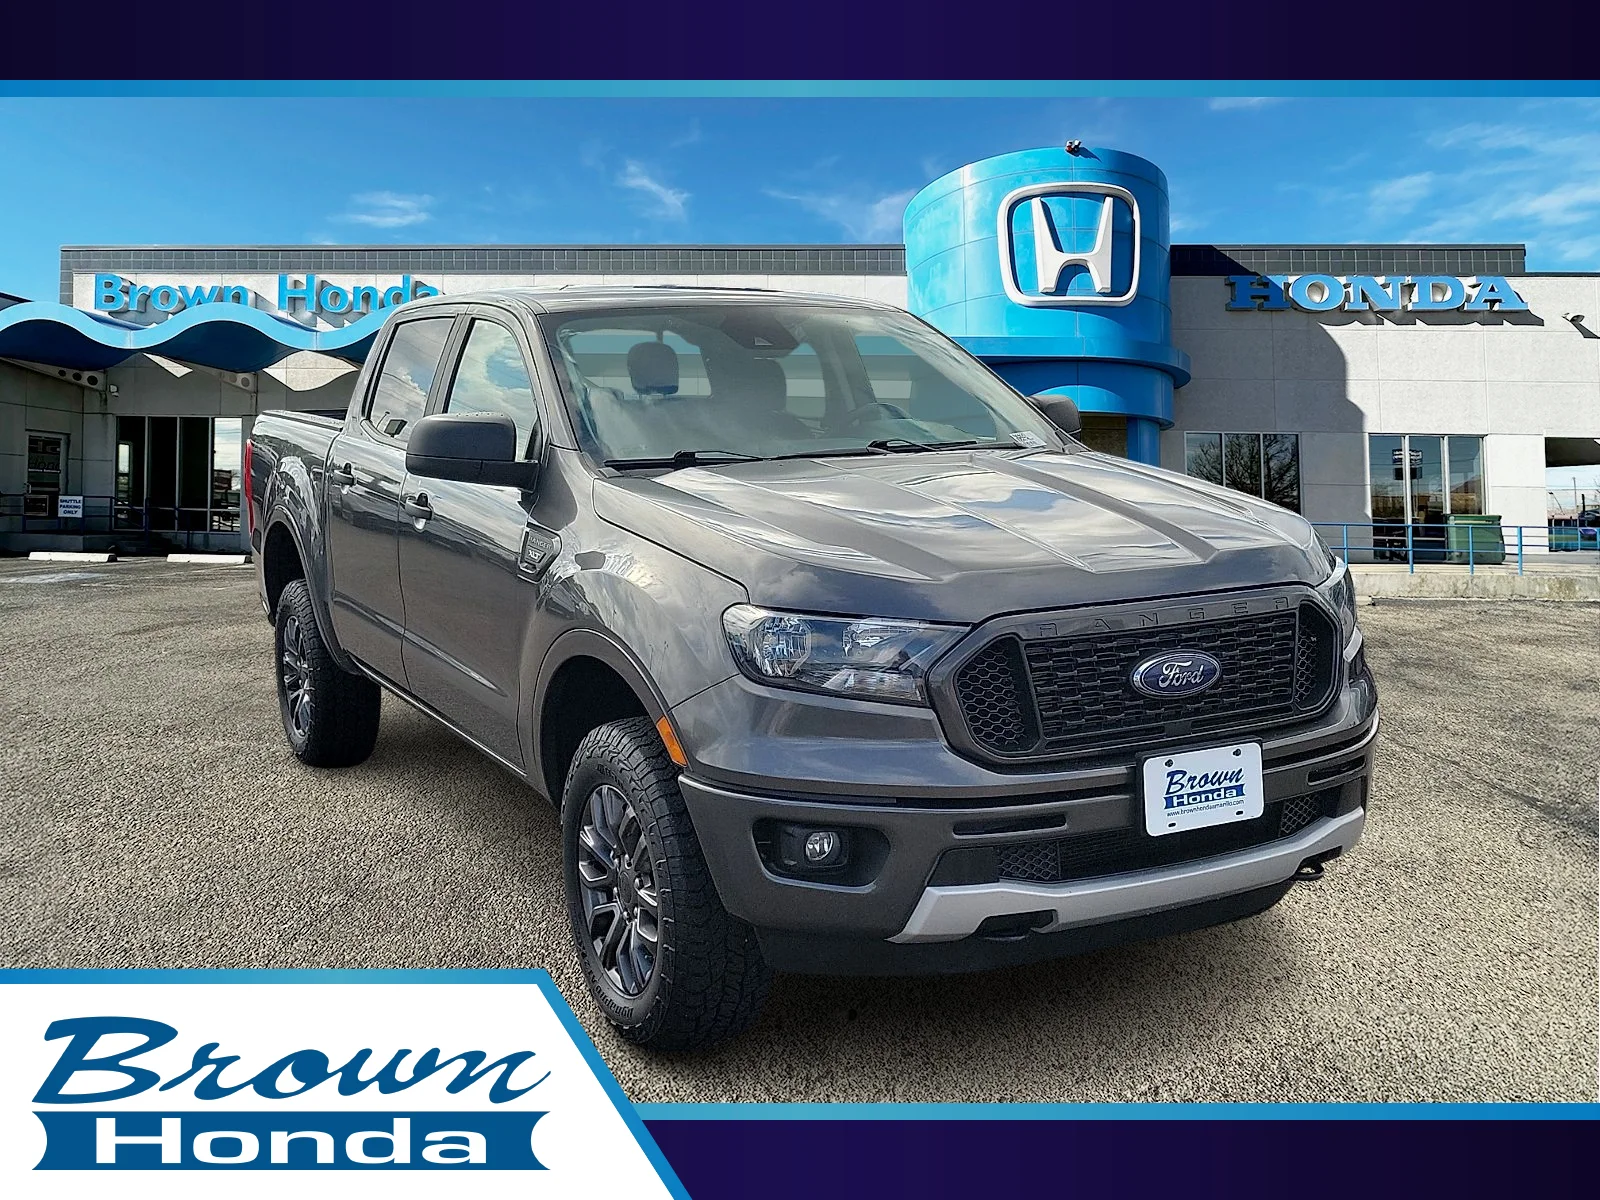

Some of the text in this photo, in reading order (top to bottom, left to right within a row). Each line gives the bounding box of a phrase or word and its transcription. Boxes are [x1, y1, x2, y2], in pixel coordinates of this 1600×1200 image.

[94, 273, 249, 312] Brown
[1228, 273, 1528, 312] HONDA
[529, 550, 541, 560] XLT
[1036, 596, 1289, 637] RANGER
[1158, 660, 1204, 688] Ford
[1165, 767, 1245, 796] Brown
[1172, 788, 1237, 807] Honda
